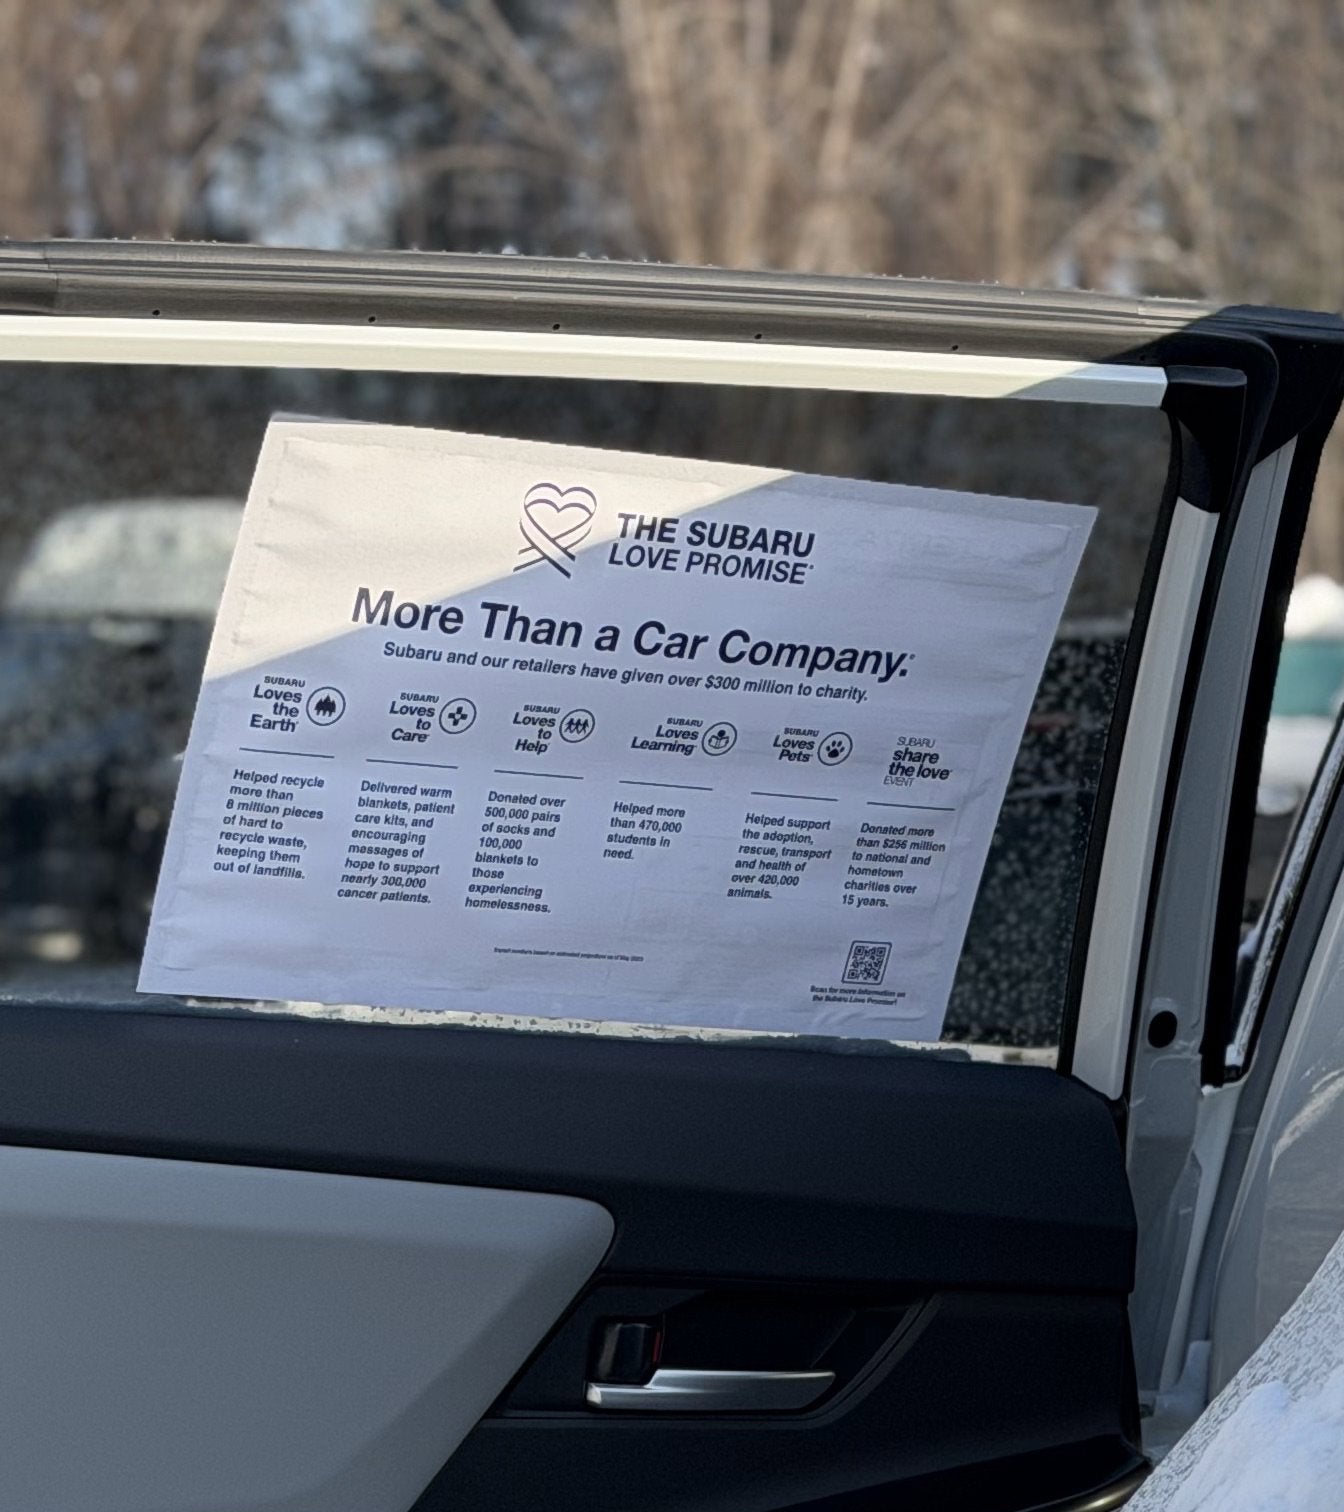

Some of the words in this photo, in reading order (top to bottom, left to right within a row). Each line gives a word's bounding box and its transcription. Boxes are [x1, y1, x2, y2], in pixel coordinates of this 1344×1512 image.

[618, 513, 679, 543] THE
[686, 520, 815, 558] SUBARU
[608, 542, 681, 571] LOVE
[351, 587, 464, 634] More
[480, 601, 582, 648] Than
[594, 625, 620, 652] a
[633, 620, 709, 660] Car
[383, 641, 443, 661] Subaru
[446, 651, 478, 665] and
[481, 655, 509, 668] our
[512, 658, 576, 675] retailers
[580, 662, 618, 679] have
[620, 668, 664, 684] given
[667, 674, 703, 687] over
[704, 674, 741, 690] $300
[743, 678, 794, 695] million
[797, 683, 812, 696] to
[815, 684, 867, 704] charity.
[264, 675, 305, 688] SUBARU
[253, 684, 302, 703] Loves
[400, 692, 439, 703] SUBARU
[273, 702, 299, 718] the
[389, 701, 435, 717] Loves
[523, 704, 561, 714] SUBARU
[416, 718, 431, 730] to
[512, 712, 556, 727] Loves
[666, 717, 703, 727] SUBARU
[537, 728, 552, 740] to
[655, 725, 699, 740] Loves
[783, 727, 820, 737] SUBARU
[515, 738, 548, 755] Help
[772, 734, 815, 750] Loves
[896, 736, 935, 748] SUBARU
[892, 747, 939, 764] share
[888, 761, 915, 777] the
[233, 769, 278, 784] Helped
[280, 776, 324, 789] recycle
[883, 775, 915, 787] EVENT
[229, 785, 263, 798] more
[266, 788, 293, 801] than
[360, 780, 417, 795] Delivered
[420, 787, 452, 798] warm
[357, 796, 411, 813] blankets,
[413, 802, 455, 814] patient
[488, 790, 537, 805] Donated
[539, 797, 566, 807] over
[226, 798, 234, 809] 8
[236, 800, 280, 814] million
[281, 806, 323, 819] pieces
[484, 806, 529, 820] 500,000
[530, 811, 560, 823] pairs
[613, 801, 654, 816] Helped
[656, 807, 686, 818] more
[223, 814, 237, 825] of
[238, 815, 268, 828] hard
[270, 819, 283, 830] to
[354, 814, 381, 824] care
[383, 814, 408, 828] kits,
[410, 817, 434, 828] and
[481, 821, 495, 832] of
[496, 824, 530, 835] socks
[532, 827, 556, 837] and
[610, 817, 636, 829] than
[638, 819, 682, 833] 470,000
[745, 812, 785, 828] Helped
[786, 818, 831, 831] support
[351, 829, 426, 846] encouraging
[742, 828, 760, 840] the
[762, 830, 813, 845] adoption,
[860, 822, 907, 835] Donated
[906, 828, 935, 837] more
[219, 831, 265, 844] recycle
[268, 836, 307, 850] waste,
[479, 836, 523, 850] 100,000
[606, 833, 657, 846] students
[659, 836, 670, 847] in
[856, 837, 880, 848] than
[909, 840, 946, 852] million
[216, 844, 266, 862] keeping
[269, 850, 300, 863] them
[348, 844, 409, 859] messages
[411, 847, 424, 858] of
[474, 851, 523, 865] blankets
[526, 855, 538, 866] to
[603, 849, 633, 859] need.
[738, 845, 778, 858] rescue,
[781, 846, 832, 860] transport
[851, 851, 863, 861] to
[865, 852, 909, 864] national
[910, 855, 932, 865] and
[213, 861, 234, 872] out
[237, 863, 251, 873] of
[253, 864, 305, 879] landfills.
[344, 857, 375, 871] hope
[378, 860, 390, 871] to
[393, 863, 440, 876] support
[472, 867, 504, 879] those
[734, 858, 757, 869] and
[758, 859, 792, 871] health
[794, 861, 807, 872] of
[847, 864, 903, 878] hometown
[340, 874, 378, 887] nearly
[731, 874, 756, 883] over
[844, 879, 890, 892] charities
[892, 884, 917, 894] over
[337, 888, 378, 899] cancer
[379, 891, 431, 903] patients.
[468, 883, 543, 899] experiencing
[727, 887, 772, 899] animals.
[465, 896, 551, 913] homelessness.
[842, 893, 855, 905] 15
[856, 897, 888, 908] years.
